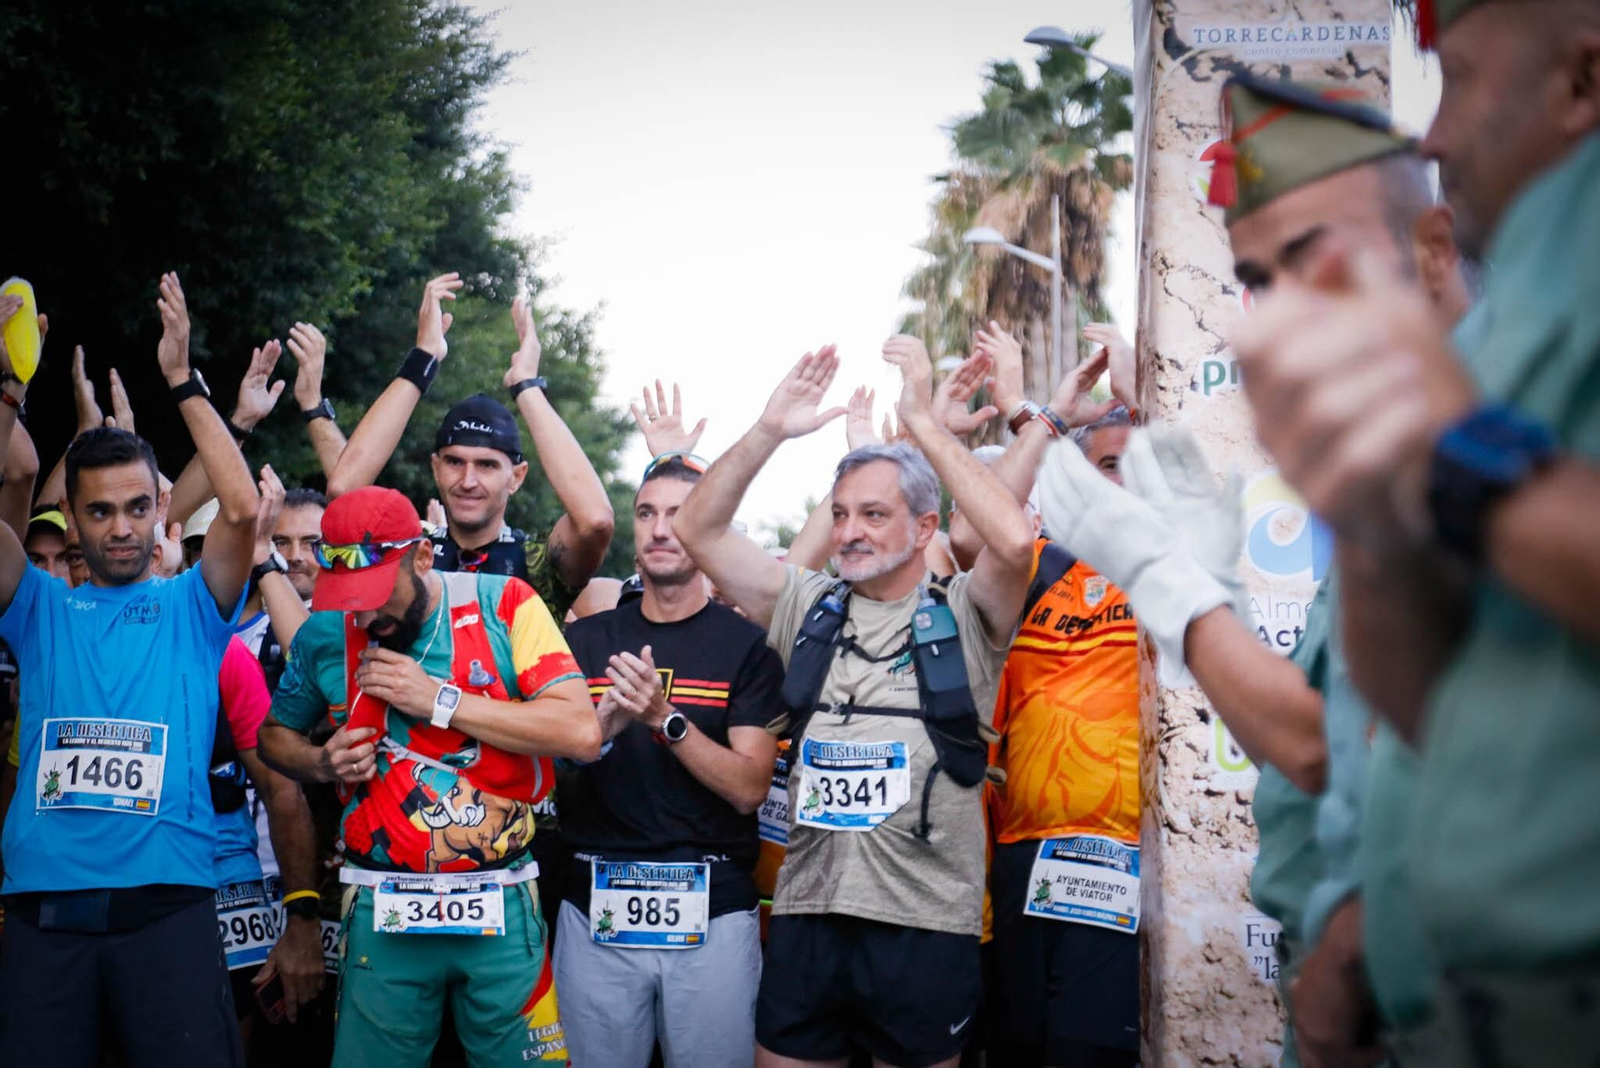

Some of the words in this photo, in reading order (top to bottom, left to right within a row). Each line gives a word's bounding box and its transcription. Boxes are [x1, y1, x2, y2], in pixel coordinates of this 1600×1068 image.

[1193, 24, 1391, 44] TORRECARDENAS
[57, 723, 74, 738] LA
[67, 755, 143, 790] 1466
[820, 776, 888, 807] 3341
[761, 806, 774, 818] DE
[607, 864, 624, 879] LA
[1056, 874, 1127, 896] AYUNTAMIENTO
[1066, 886, 1077, 897] DE
[1080, 889, 1113, 903] VIATOR
[407, 899, 485, 922] 3405
[627, 896, 681, 927] 985
[218, 912, 275, 948] 2968
